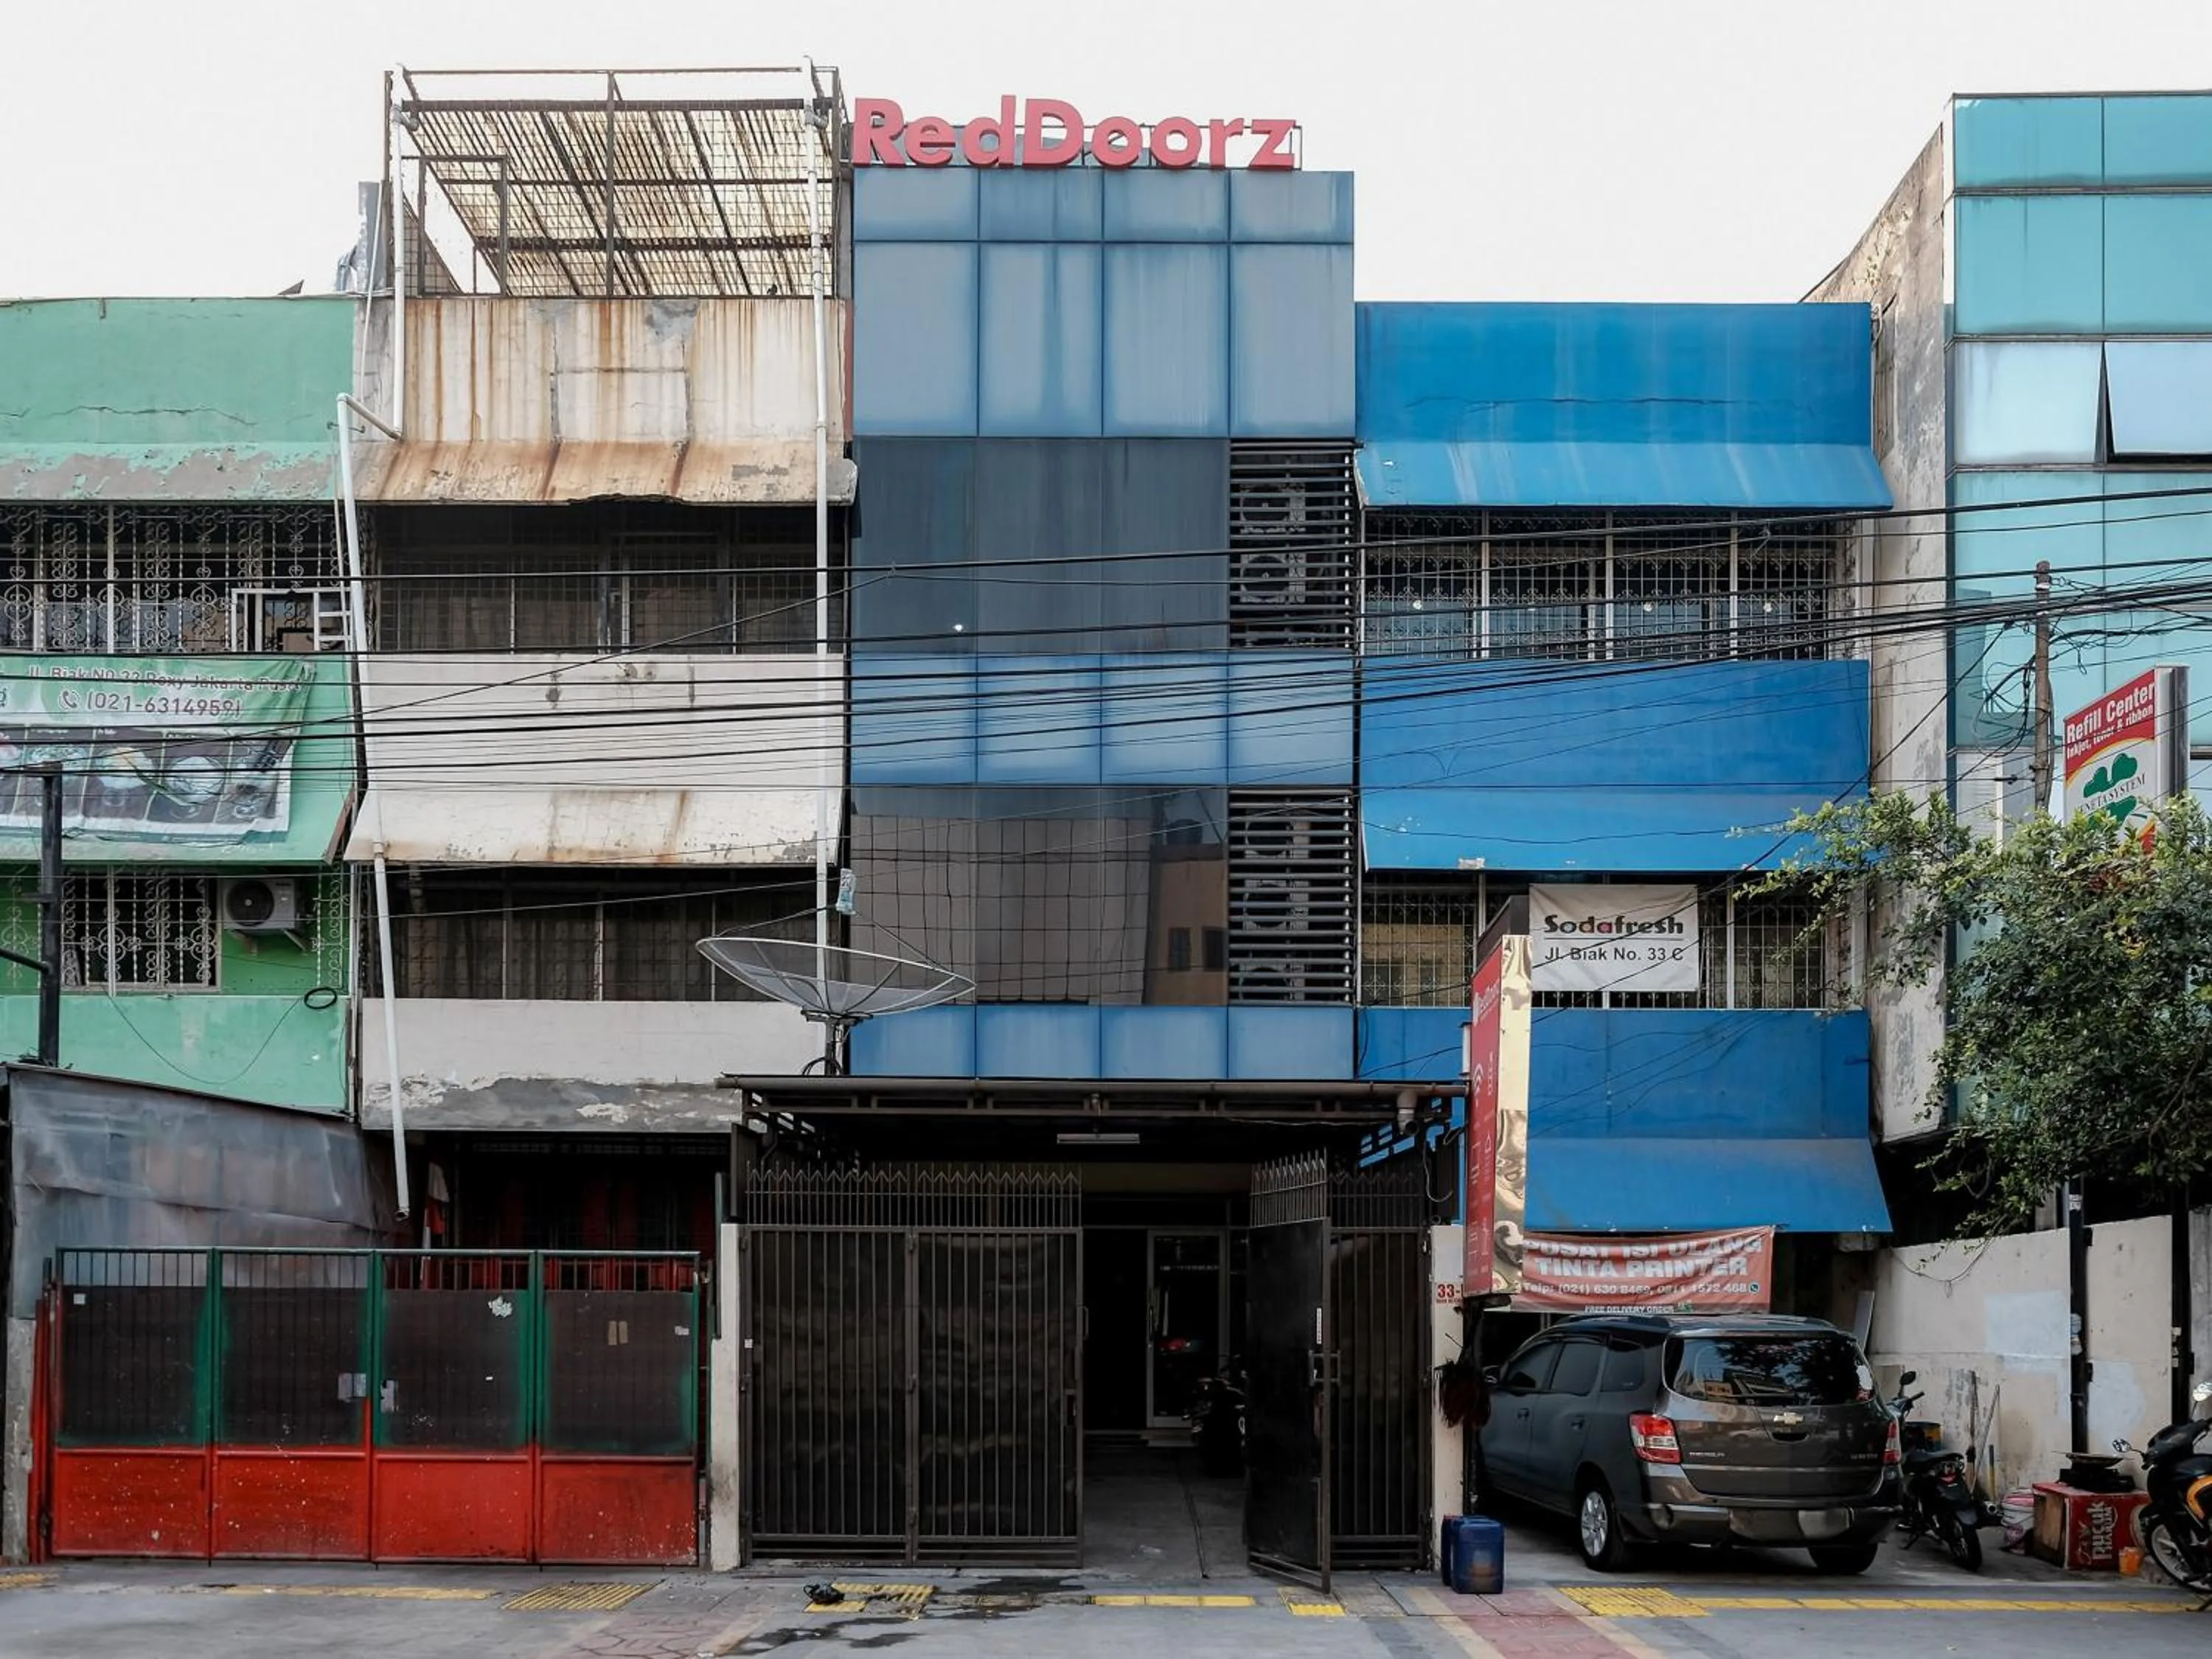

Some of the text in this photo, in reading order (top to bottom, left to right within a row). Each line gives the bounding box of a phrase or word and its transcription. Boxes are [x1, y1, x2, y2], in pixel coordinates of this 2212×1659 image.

[852, 94, 1296, 171] RedDoorz
[2067, 683, 2154, 744] Refill Center
[1544, 914, 1683, 934] Sodafresh
[1571, 947, 1607, 961] Biak
[1614, 947, 1641, 961] No.
[1648, 947, 1665, 961] 33
[1672, 947, 1683, 961] C
[1536, 1257, 1748, 1278] TINTA PRINTER
